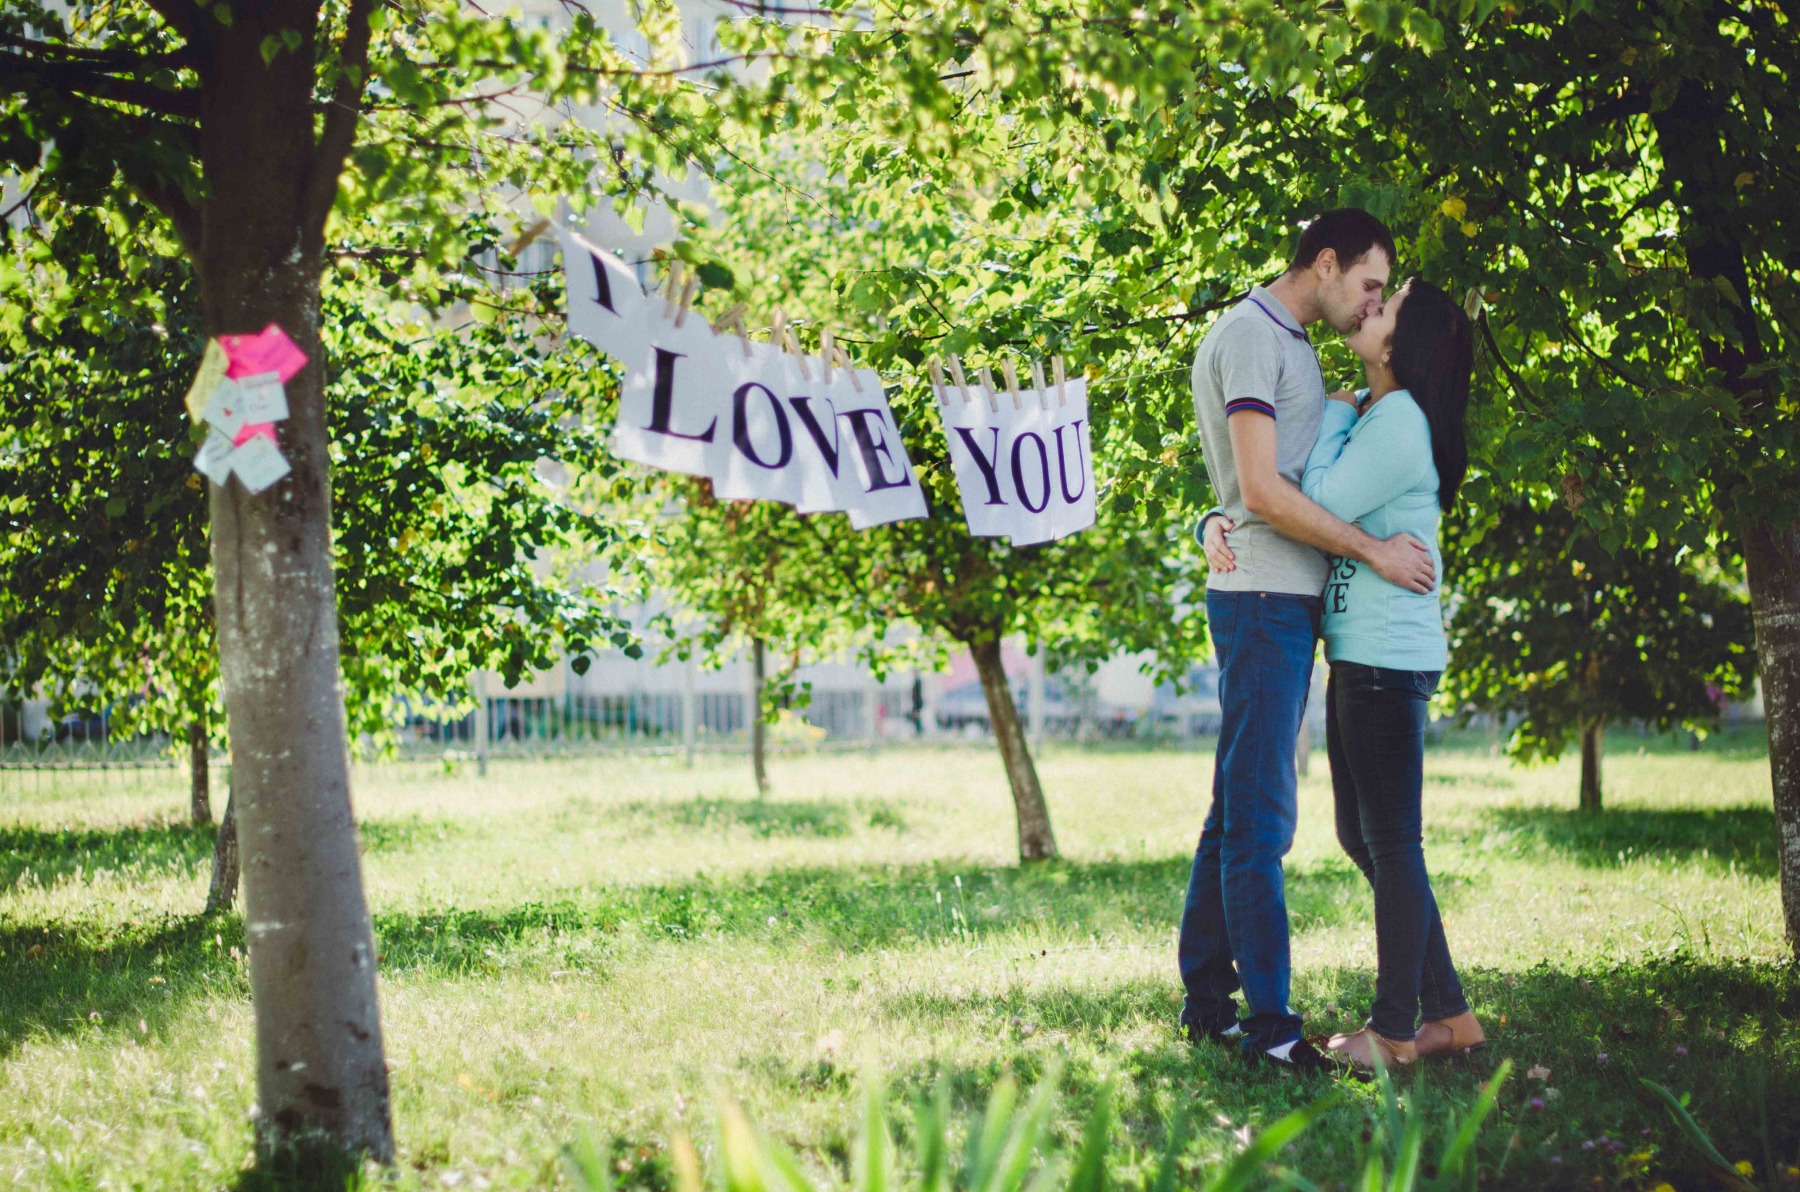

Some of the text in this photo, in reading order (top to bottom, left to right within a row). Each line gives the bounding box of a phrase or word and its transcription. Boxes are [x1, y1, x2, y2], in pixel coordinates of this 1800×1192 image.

[588, 250, 1085, 514] I LOVE YOU
[1330, 556, 1359, 580] RS
